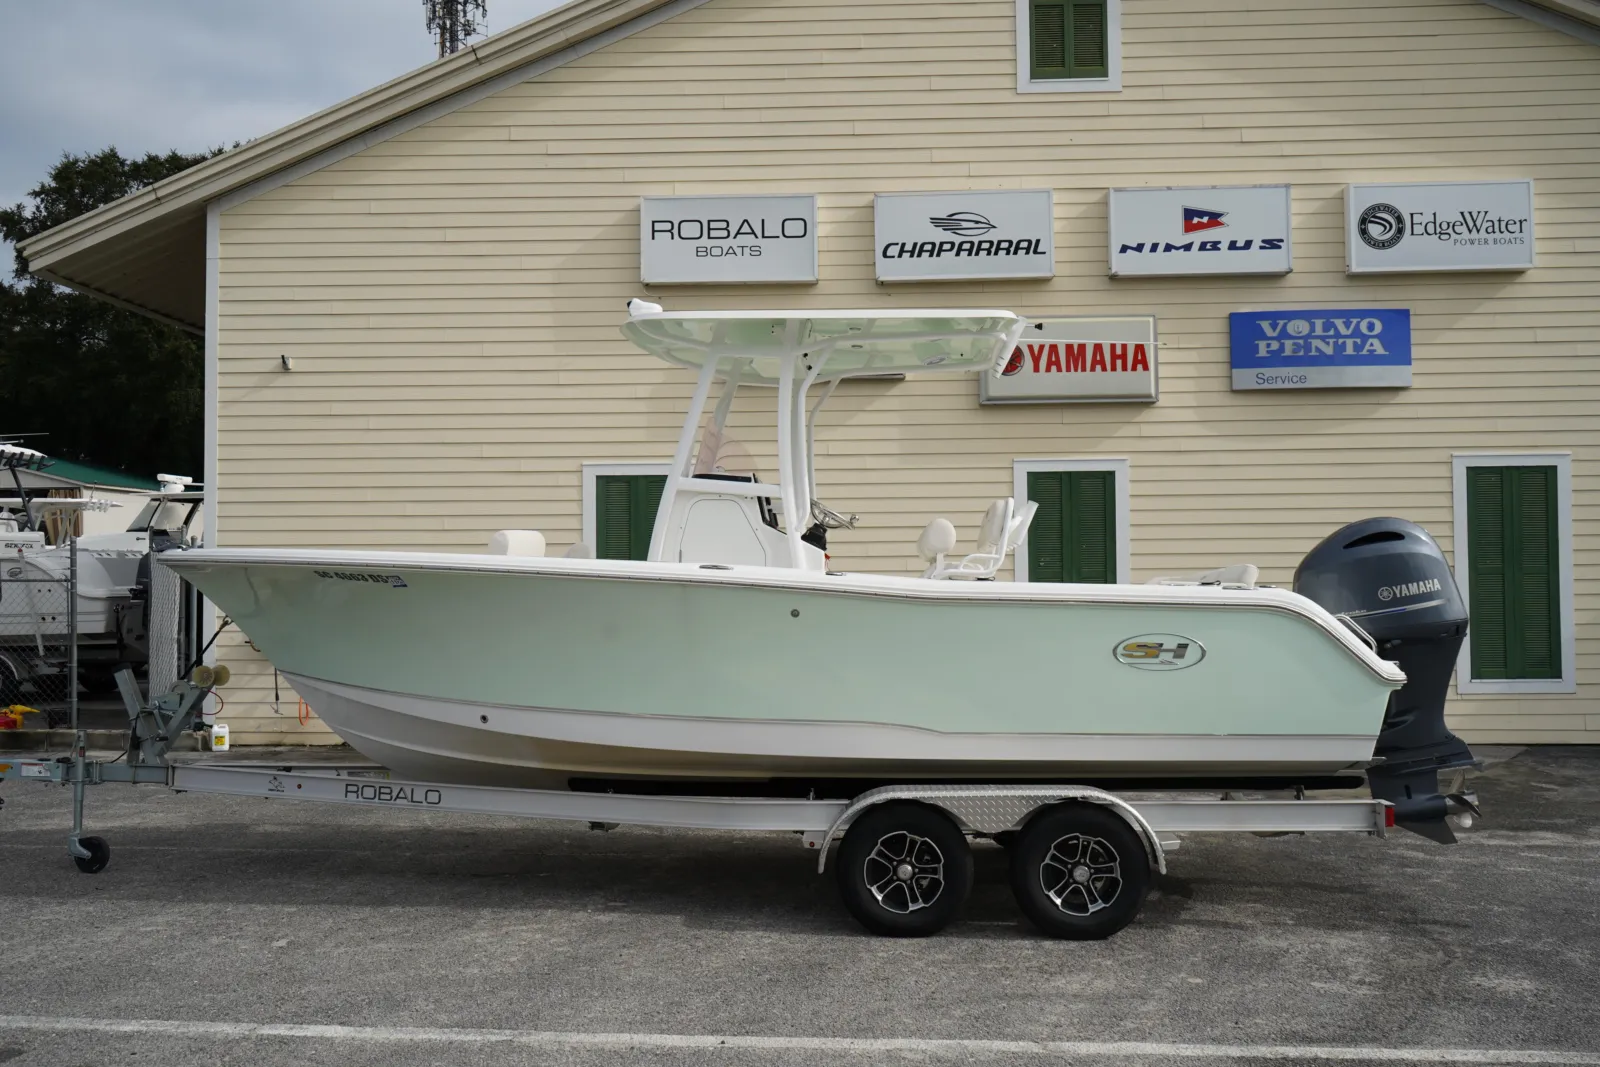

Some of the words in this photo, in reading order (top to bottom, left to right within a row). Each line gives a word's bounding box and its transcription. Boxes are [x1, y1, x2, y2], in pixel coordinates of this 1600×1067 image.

[651, 217, 807, 241] ROBALO
[1409, 210, 1528, 241] EdgeWater
[882, 238, 1047, 259] CHAPARRAL
[1118, 238, 1285, 254] NIMBUS
[1453, 238, 1489, 246] POWER
[1493, 236, 1525, 245] BOATS
[695, 245, 762, 257] BOATS
[1256, 318, 1383, 337] VOLVO
[1255, 338, 1389, 357] PENTA
[1027, 343, 1150, 373] YAMAHA
[1255, 372, 1307, 386] Service
[1393, 578, 1441, 598] YAMAHA
[344, 783, 442, 805] ROBALO
